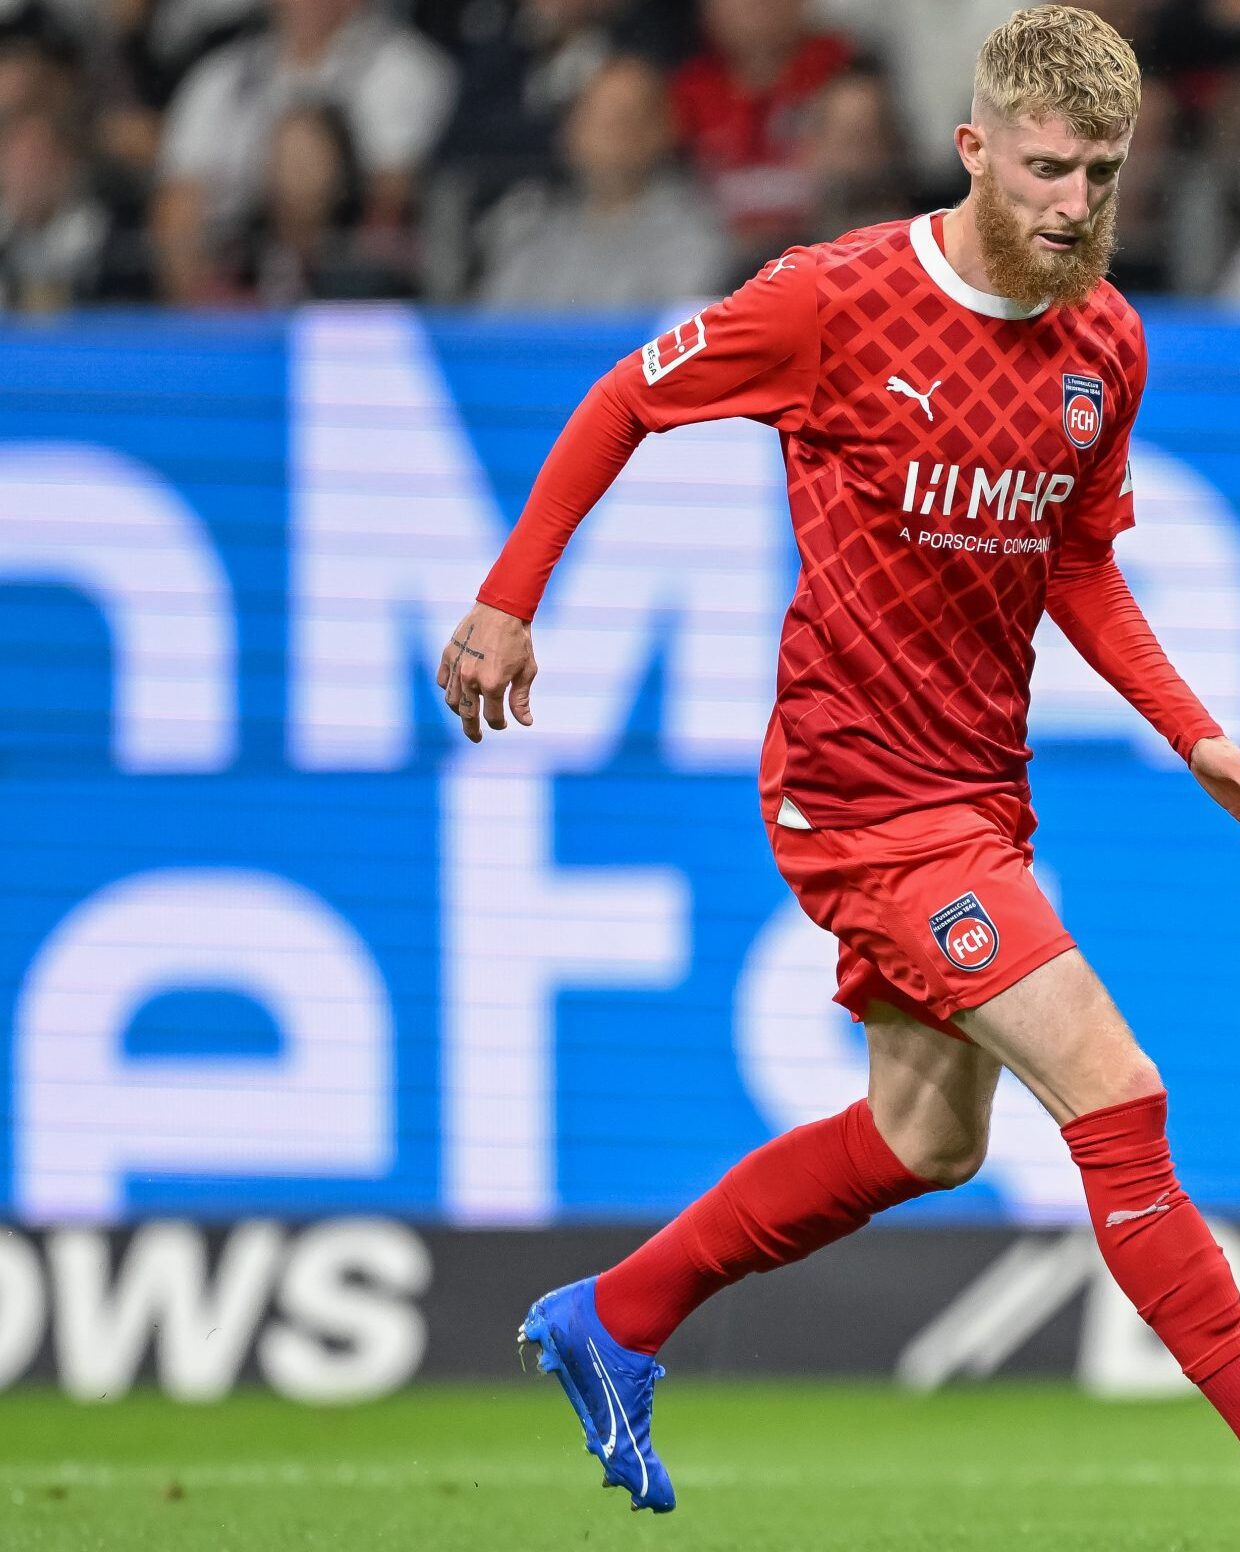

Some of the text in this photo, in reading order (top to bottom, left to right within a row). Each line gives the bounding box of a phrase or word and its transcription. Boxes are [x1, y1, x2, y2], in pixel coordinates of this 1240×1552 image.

[1071, 408, 1095, 432] FCH
[966, 467, 1075, 522] MHP
[899, 527, 1051, 554] A PORSCHE COMPAN
[962, 902, 977, 914] 1846
[952, 925, 989, 960] FCH
[0, 1215, 434, 1404] WS
